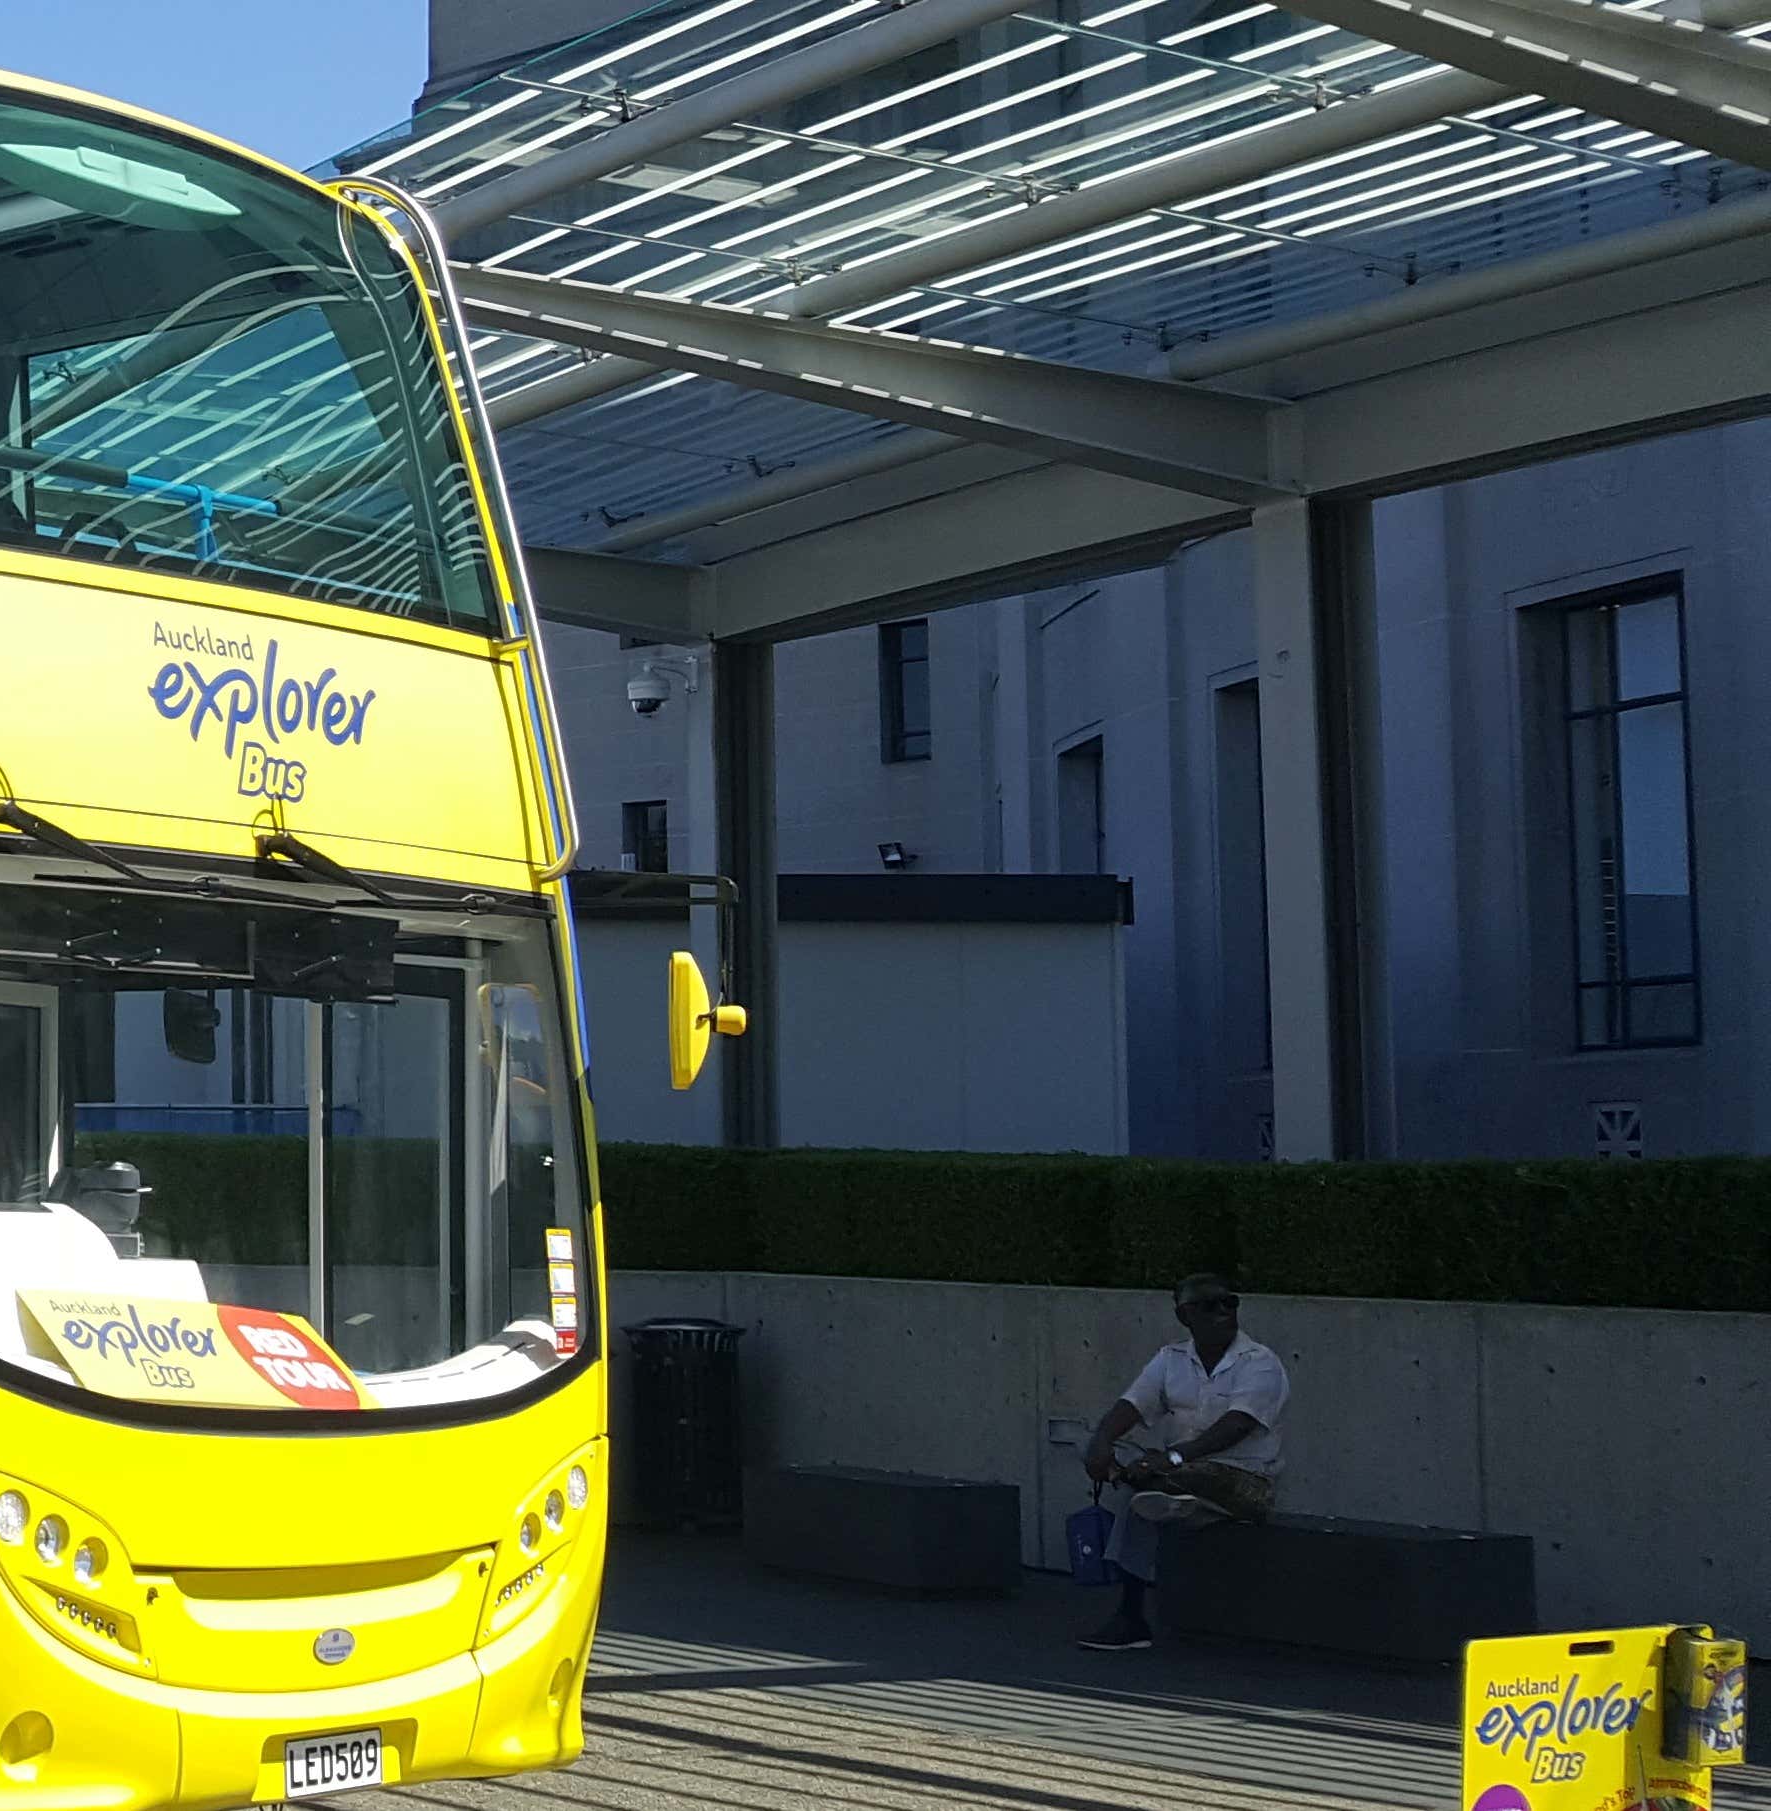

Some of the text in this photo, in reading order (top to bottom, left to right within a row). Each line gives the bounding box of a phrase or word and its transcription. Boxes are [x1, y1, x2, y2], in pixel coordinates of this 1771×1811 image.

[152, 621, 254, 662] Auckland
[148, 639, 376, 759] explorer
[237, 741, 307, 803] Bus
[49, 1300, 121, 1317] Auckland
[61, 1304, 218, 1368] explorer
[237, 1325, 308, 1358] RED
[139, 1358, 195, 1388] Bus
[252, 1357, 351, 1392] TOUR
[1485, 1676, 1559, 1699] Auckland
[1475, 1674, 1653, 1762] explorer
[288, 1736, 379, 1789] LED509
[1532, 1747, 1585, 1784] Bus
